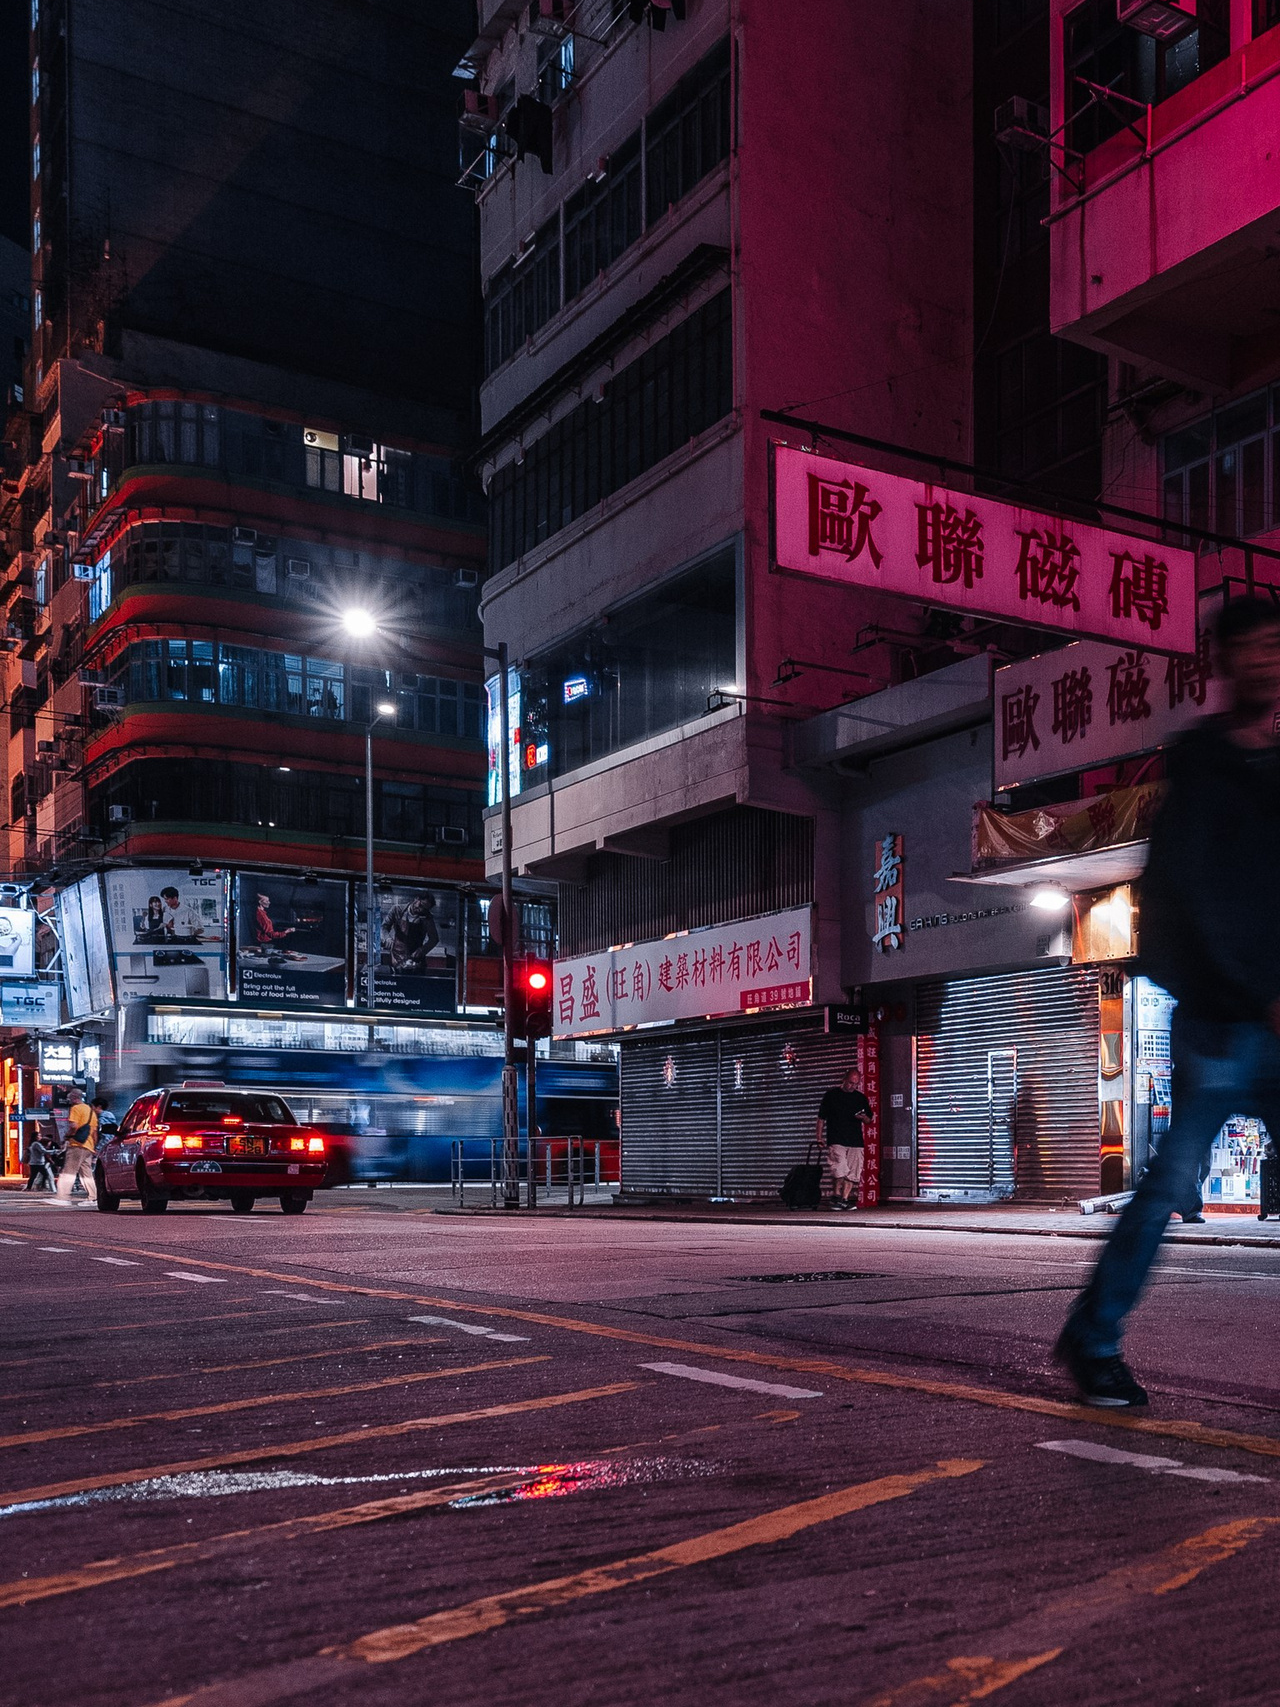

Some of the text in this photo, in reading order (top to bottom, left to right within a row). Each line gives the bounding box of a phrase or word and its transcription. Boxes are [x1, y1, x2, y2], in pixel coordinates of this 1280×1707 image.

[806, 471, 1170, 631] 歐聯磁磚
[191, 878, 217, 886] TGC
[243, 983, 261, 991] Bring
[1101, 972, 1124, 995] 316
[12, 996, 46, 1006] TGC
[836, 1011, 862, 1025] Roca
